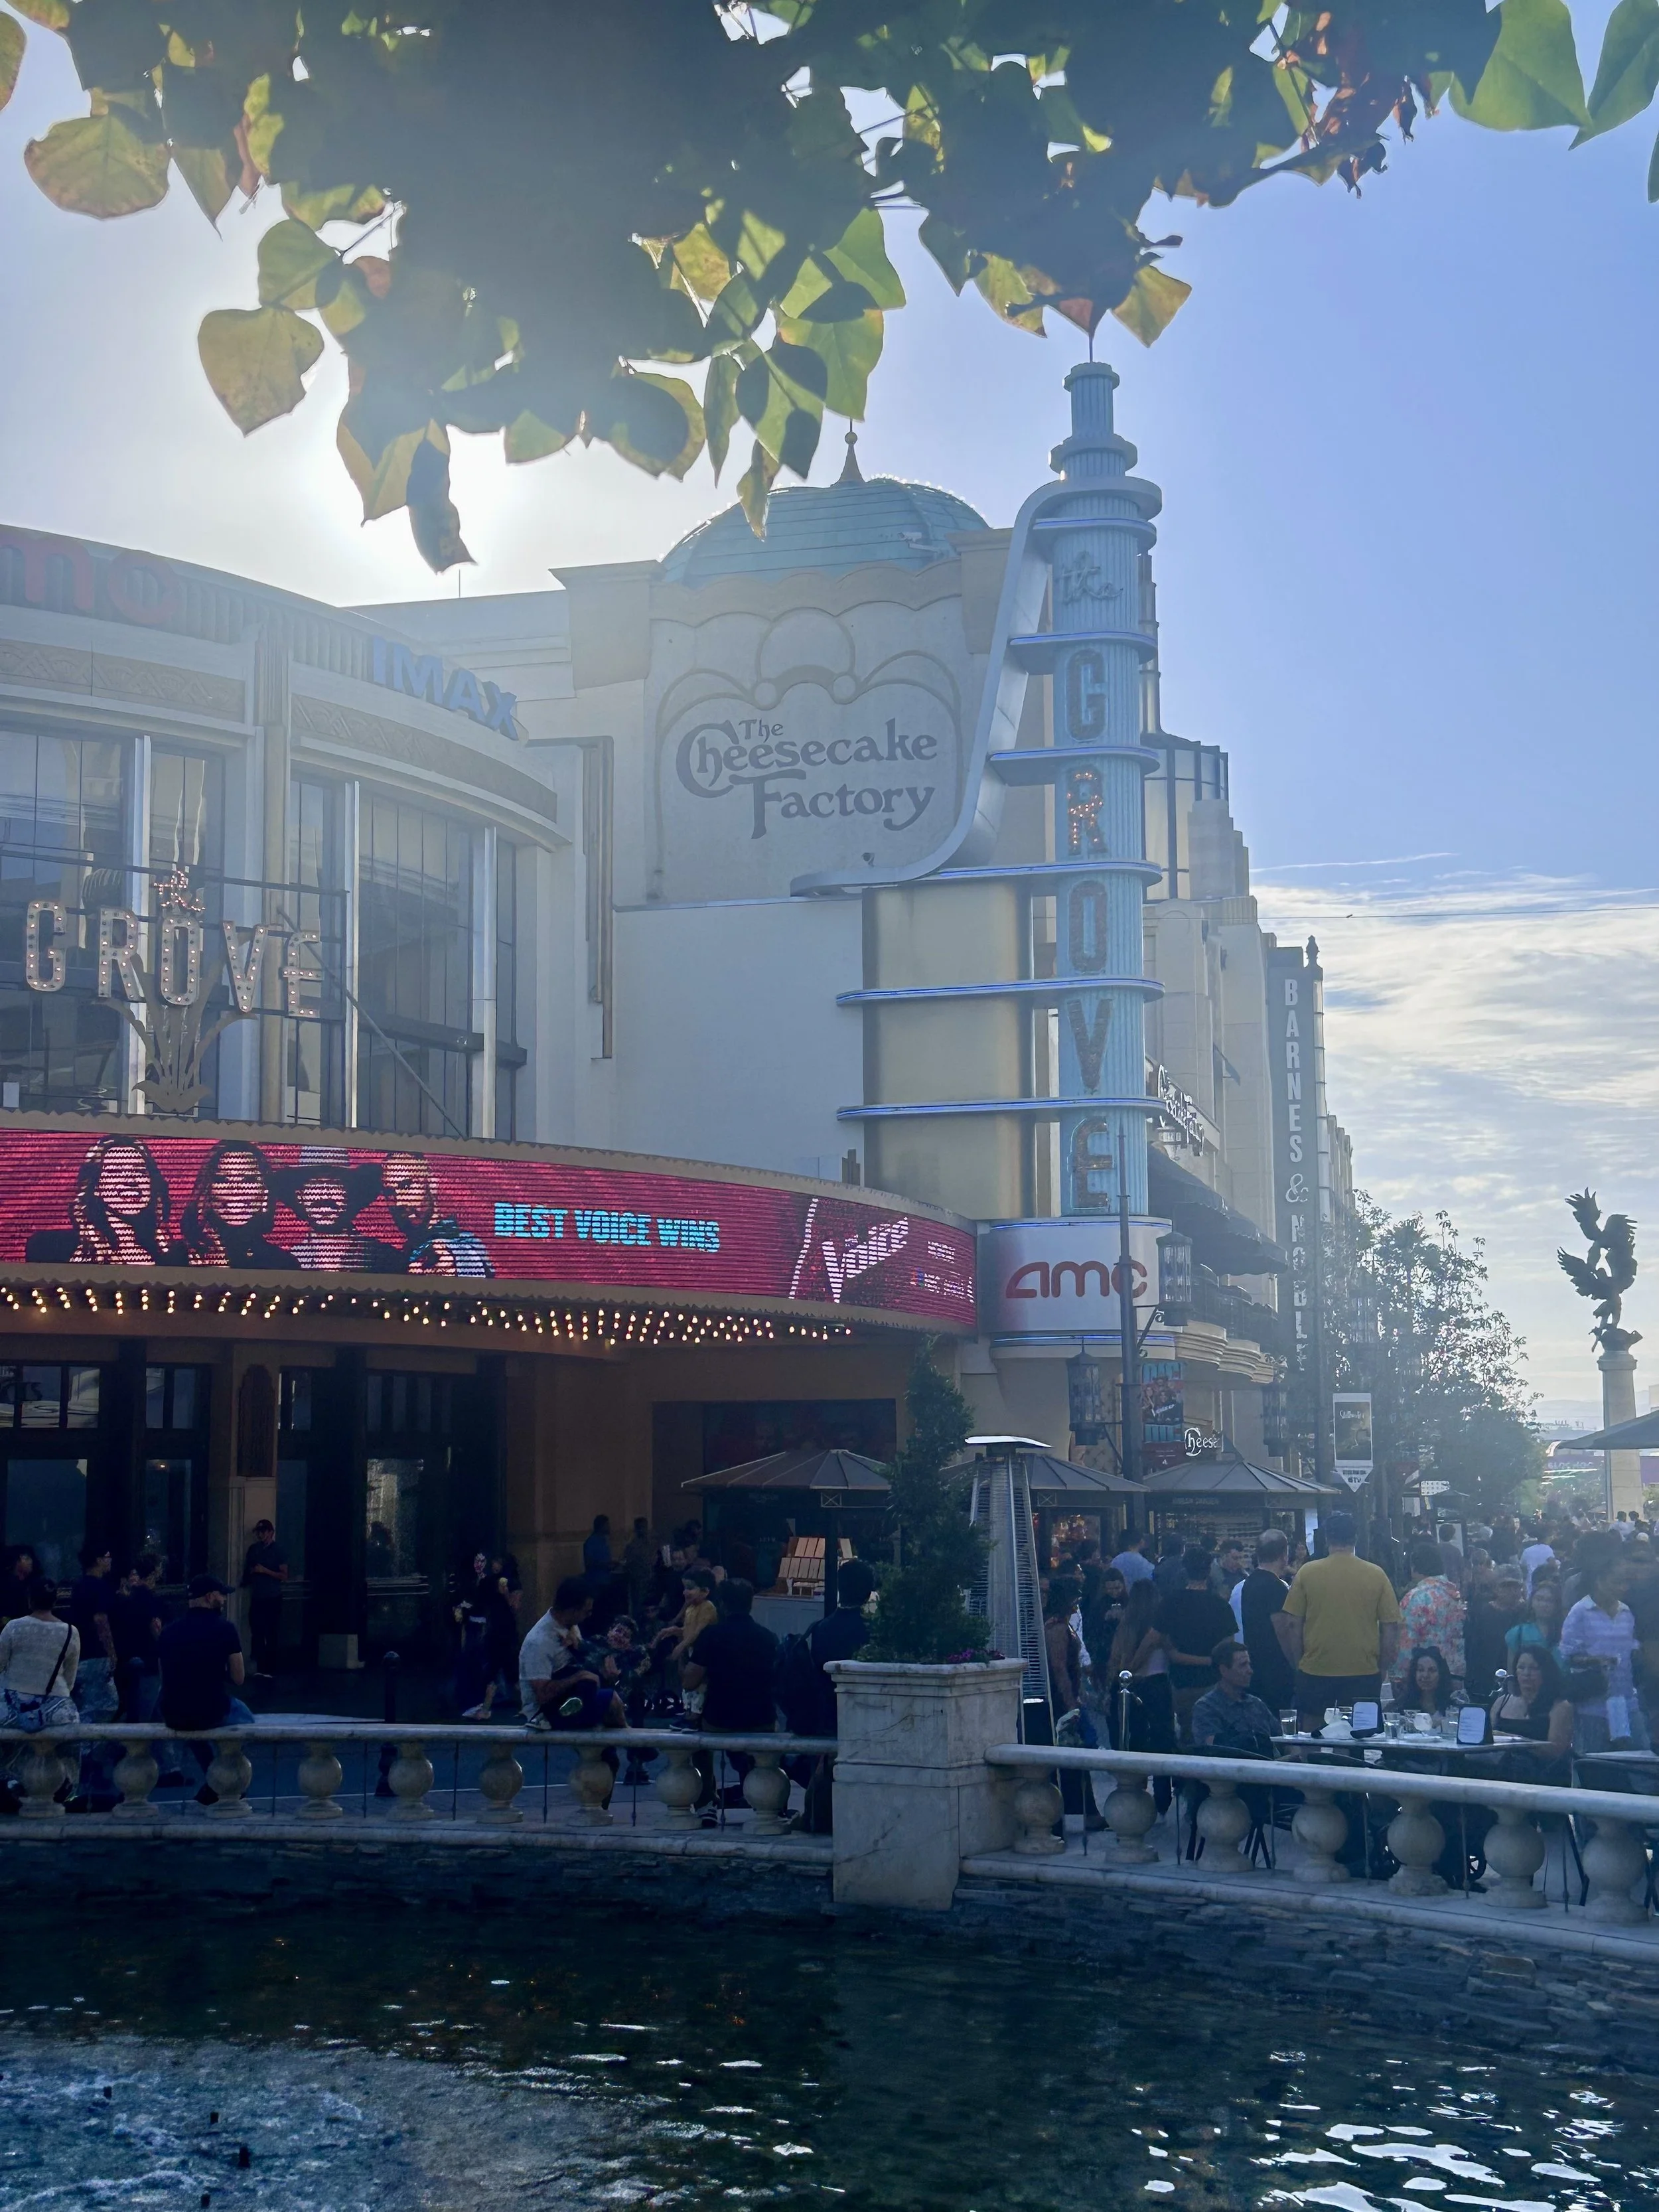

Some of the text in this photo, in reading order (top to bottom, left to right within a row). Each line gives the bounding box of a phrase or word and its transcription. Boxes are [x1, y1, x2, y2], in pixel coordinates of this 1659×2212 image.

[368, 634, 520, 741] IMAX
[676, 717, 938, 798] Cheesecake
[739, 718, 784, 743] The
[729, 769, 936, 840] Factory
[26, 900, 324, 1018] GROVE
[1065, 649, 1115, 1209] GROVE
[1285, 978, 1303, 1163] BARNES
[494, 1202, 721, 1254] BEST VOICE WINS
[1005, 1260, 1147, 1299] amc
